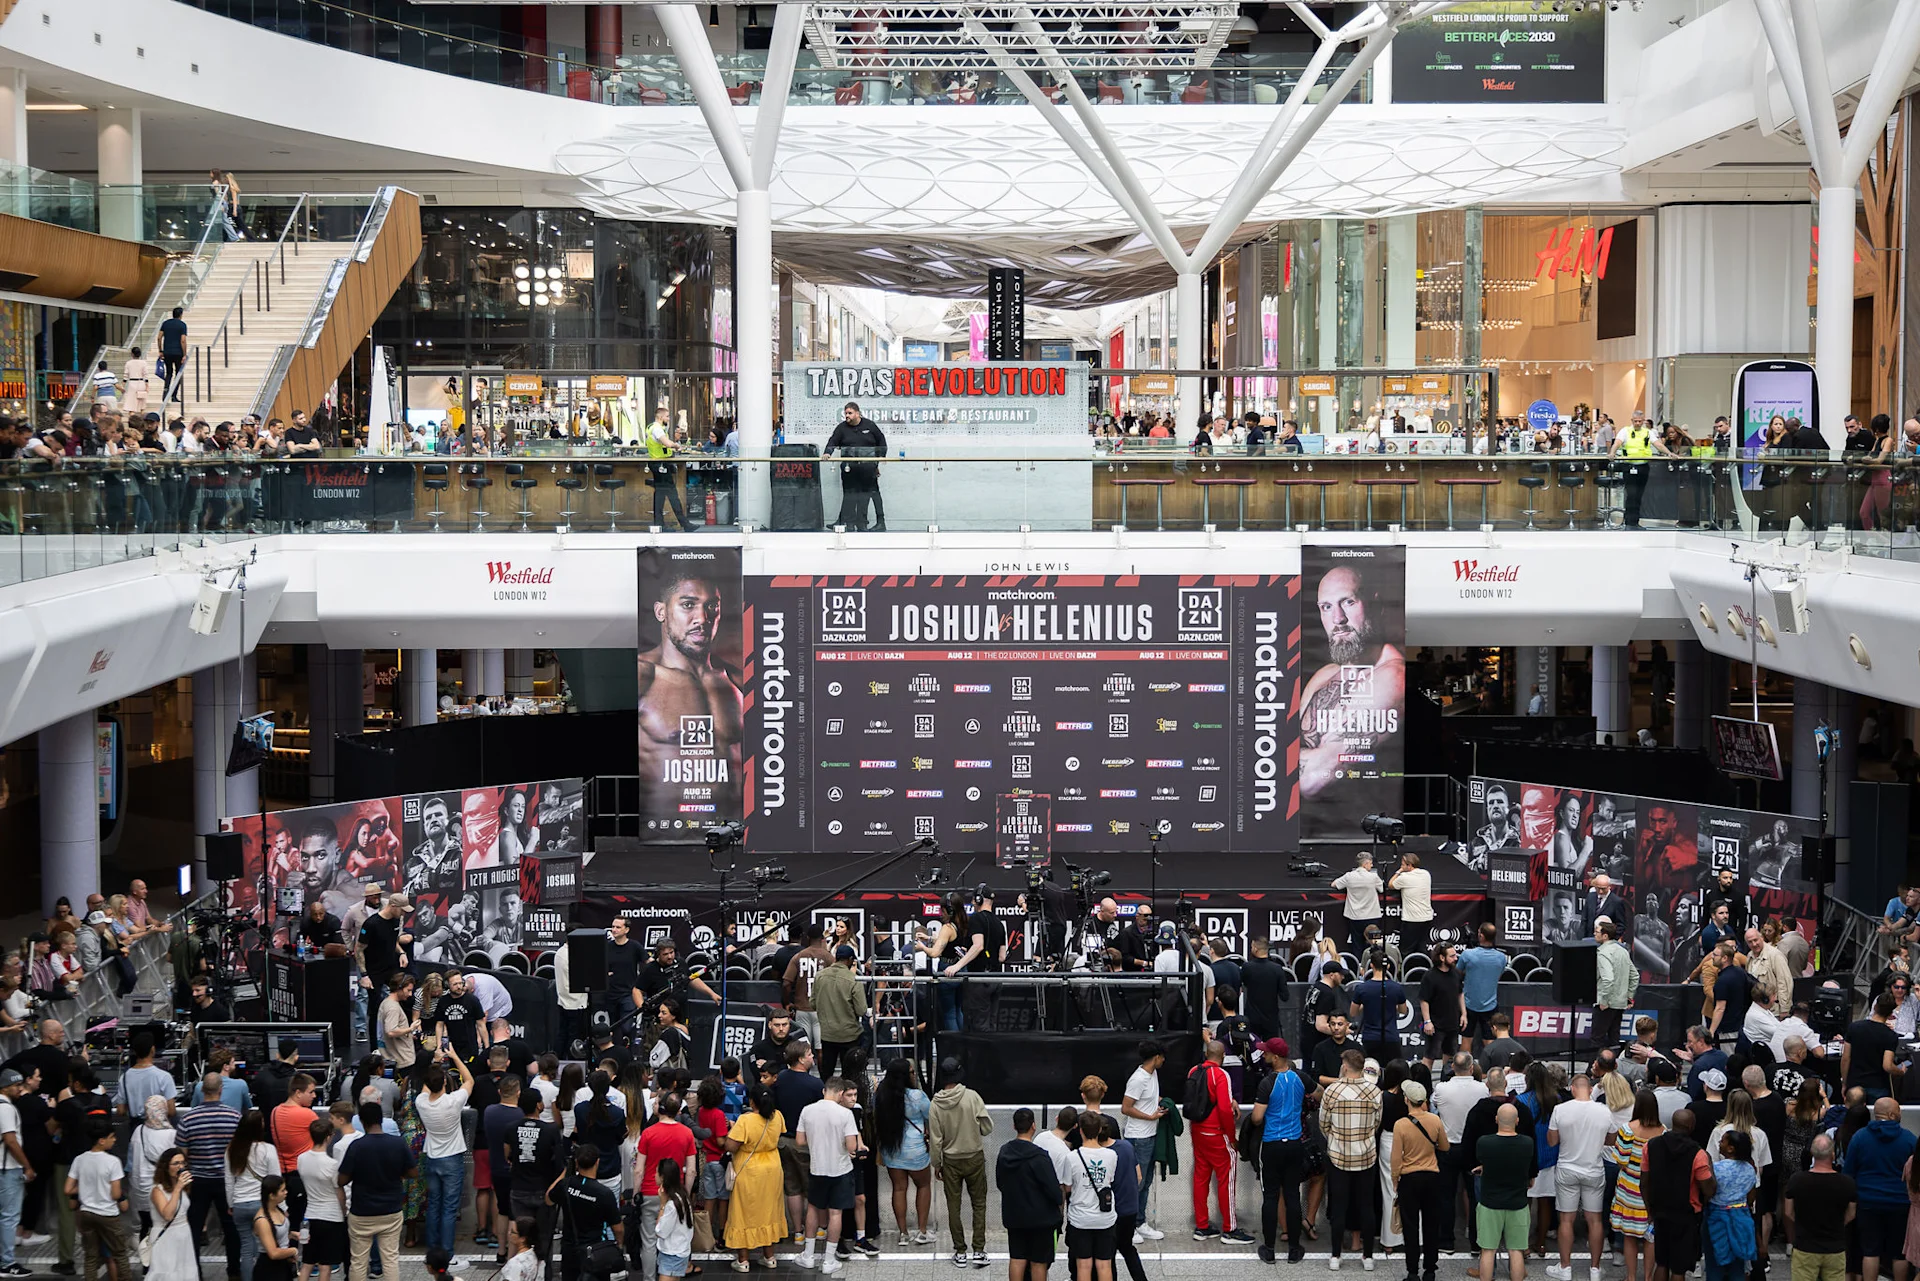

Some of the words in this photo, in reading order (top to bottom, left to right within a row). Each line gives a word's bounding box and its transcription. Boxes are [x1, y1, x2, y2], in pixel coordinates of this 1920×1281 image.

[1432, 14, 1468, 22] WESTFIELD
[1470, 14, 1496, 22] LONDON
[1498, 14, 1504, 22] IS
[1505, 14, 1527, 22] PROUD
[1529, 14, 1538, 22] TO
[1539, 14, 1569, 22] SUPPORT
[1482, 78, 1515, 91] Westfield
[1534, 226, 1615, 280] H&M
[510, 383, 538, 391] CERVEZA
[1146, 380, 1168, 389] JAMÓN
[1304, 381, 1330, 391] SANGRÍA
[841, 410, 888, 421] SNISH
[892, 410, 918, 421] CAFE
[922, 410, 943, 421] BAR
[961, 410, 1030, 421] RESTAURANT
[776, 464, 812, 473] TAPAS
[305, 464, 368, 486] Westfield
[313, 489, 344, 498] LONDON
[346, 489, 360, 498] W12
[485, 561, 555, 584] Westfield
[985, 563, 1020, 572] JOHN
[1027, 563, 1070, 571] LEWIS
[1452, 560, 1521, 582] Westfield
[494, 591, 528, 600] LONDON
[531, 591, 547, 600] W12
[988, 590, 1057, 600] matchroom.
[1460, 589, 1493, 598] LONDON
[1496, 589, 1512, 598] W12
[888, 604, 1000, 641] JOSHUA
[1014, 604, 1153, 641] HELENIUS
[822, 634, 866, 642] DAZN.COM
[763, 612, 793, 816] matchroom.
[1007, 715, 1036, 724] JOSHUA
[1254, 612, 1286, 821] matchroom.
[1316, 709, 1398, 733] HELENIUS
[1003, 724, 1041, 732] HELENIUS
[663, 759, 728, 782] JOSHUA
[680, 804, 715, 812] BETFRED
[1007, 817, 1038, 825] JOSHUA
[1710, 819, 1741, 828] matchroom
[1003, 825, 1042, 834] HELENIUS
[470, 872, 487, 886] 12TH
[491, 868, 520, 883] AUGUST
[546, 874, 575, 887] JOSHUA
[1492, 870, 1526, 883] HELENIUS
[621, 906, 688, 917] matchroom
[530, 914, 561, 922] JOSHUA
[736, 911, 765, 924] LIVE
[1270, 911, 1298, 924] LIVE
[525, 922, 566, 931] HELENIUS
[1208, 917, 1236, 934] DA
[1270, 925, 1323, 941] DAN
[1520, 1011, 1650, 1034] BETFED
[725, 1026, 755, 1043] 258
